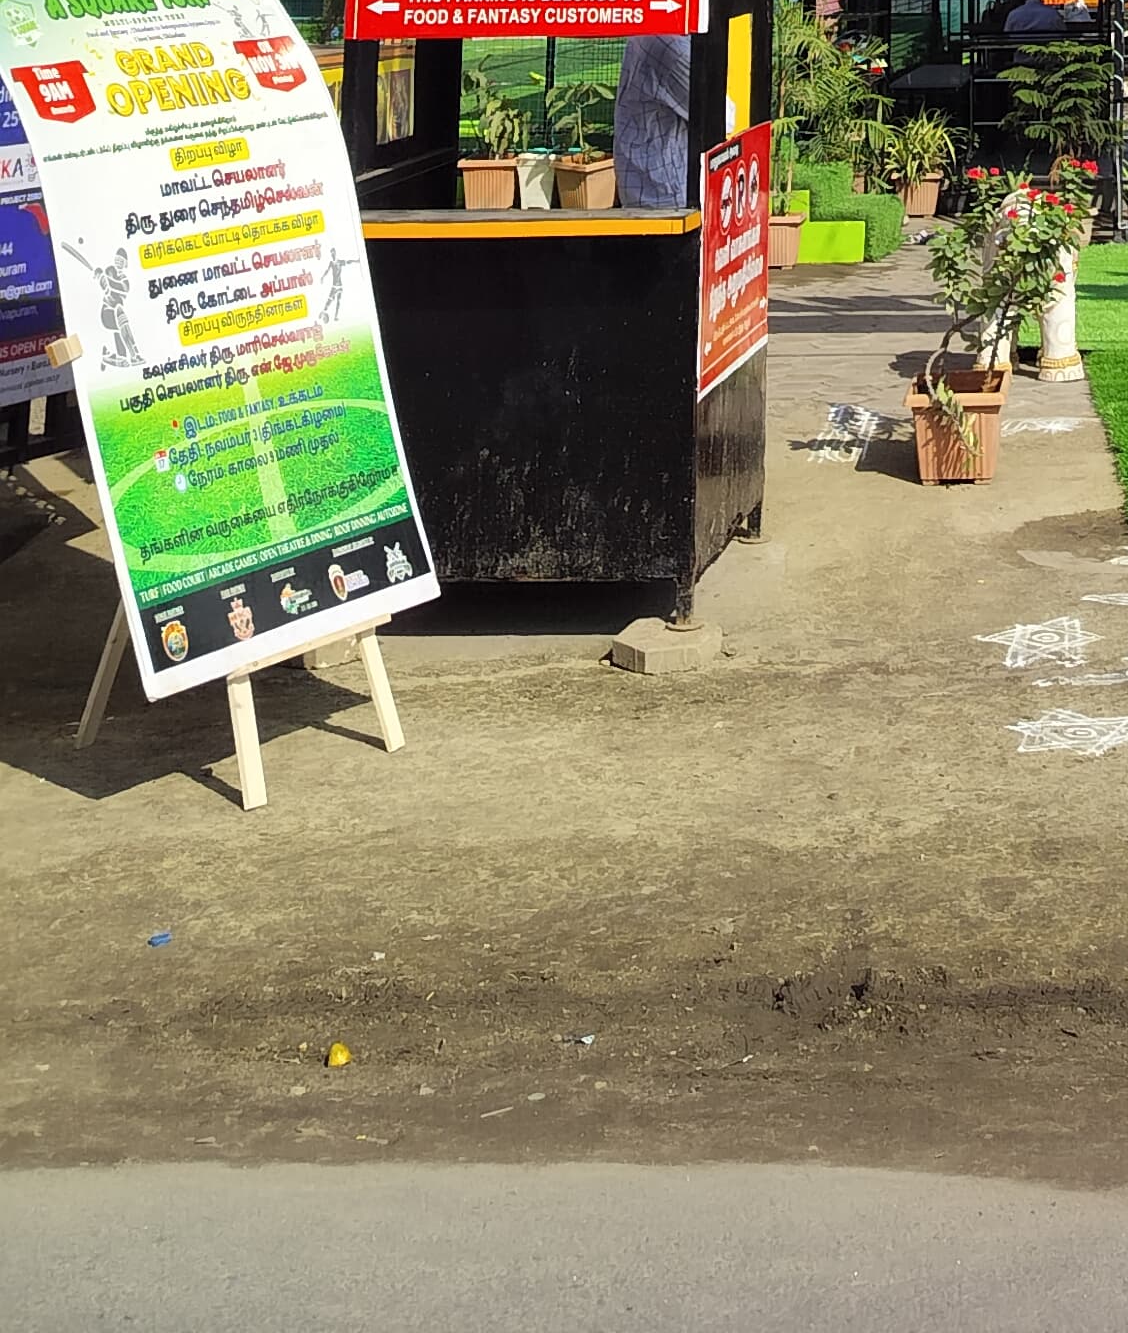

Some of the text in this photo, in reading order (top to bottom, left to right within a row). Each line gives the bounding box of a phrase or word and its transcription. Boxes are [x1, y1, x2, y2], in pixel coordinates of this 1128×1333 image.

[403, 6, 644, 25] FOOD & FANTASY CUSTOMERS
[115, 42, 215, 77] GRAND
[32, 67, 61, 81] Time
[38, 81, 75, 103] 9AM
[105, 68, 251, 118] OPENING
[214, 139, 243, 157] விழா
[160, 158, 286, 197] மாவட்ட செயலாளர்
[291, 215, 318, 231] விழா
[141, 590, 160, 604] TURF
[163, 581, 182, 597] FOOD
[183, 572, 205, 591] COURT
[209, 562, 232, 582] ARCADE
[233, 554, 257, 574] GAMES
[260, 546, 276, 563] OPEN
